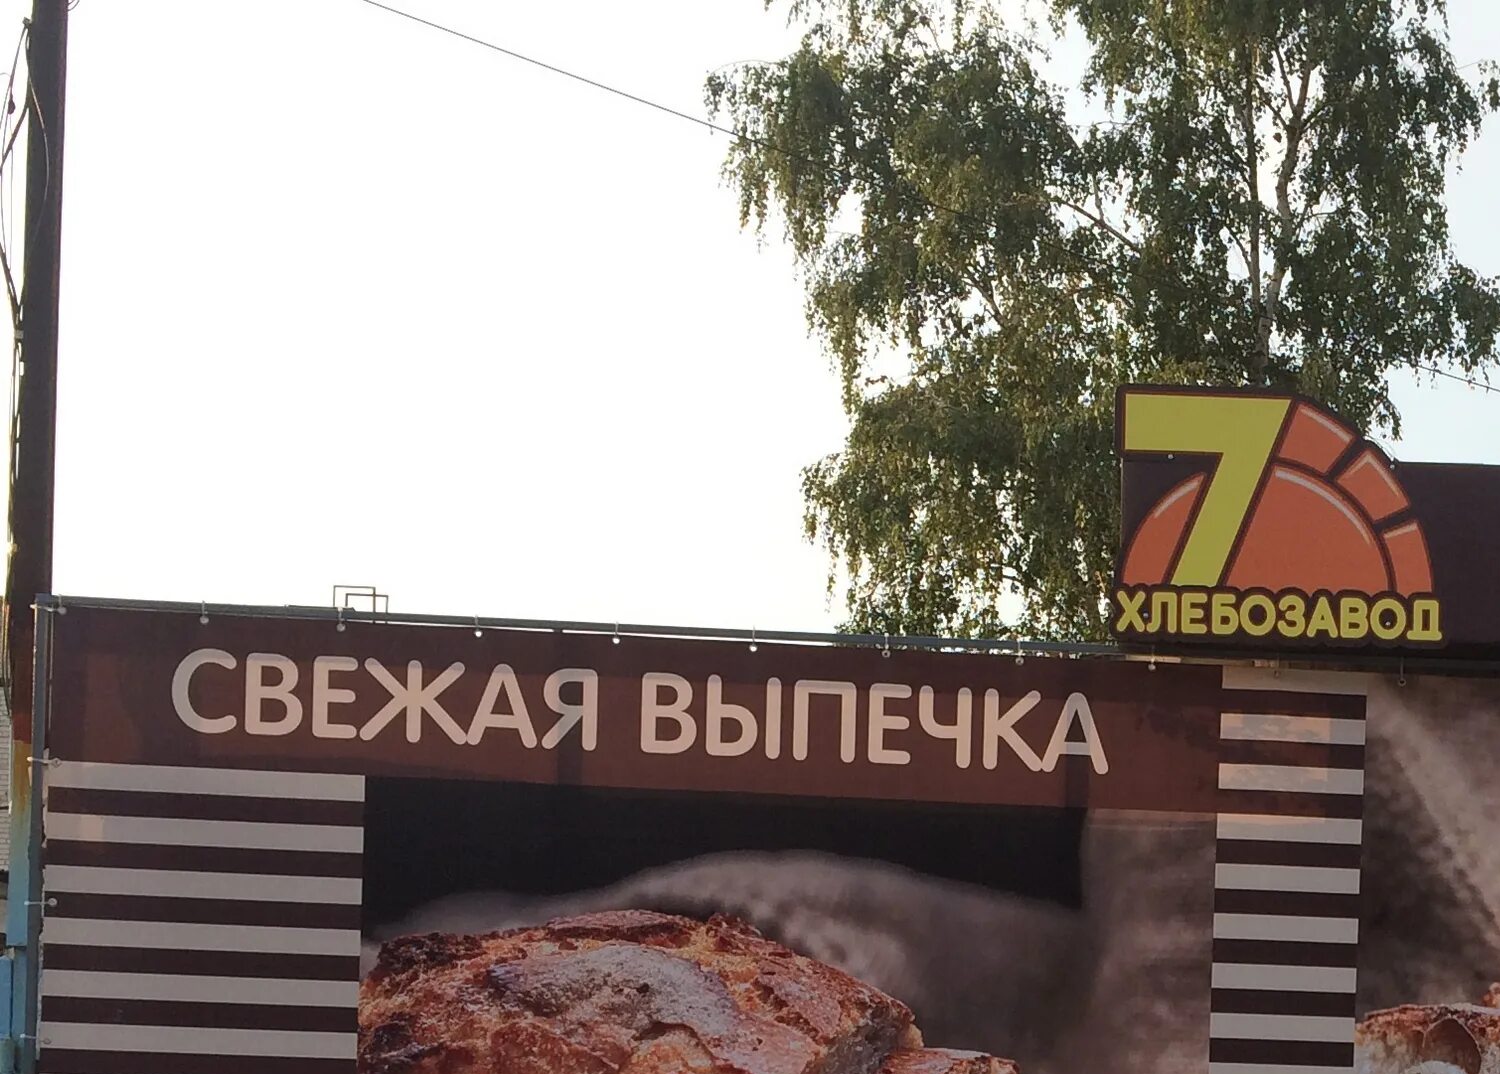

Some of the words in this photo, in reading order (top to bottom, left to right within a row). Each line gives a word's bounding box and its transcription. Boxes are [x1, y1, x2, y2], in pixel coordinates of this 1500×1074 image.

[1124, 393, 1293, 587] 7
[1116, 591, 1443, 642] ХЛЕБОЗАВОД
[170, 648, 600, 751] СВЕЖАЯ
[639, 671, 1109, 775] ВЫПЕЧКА
